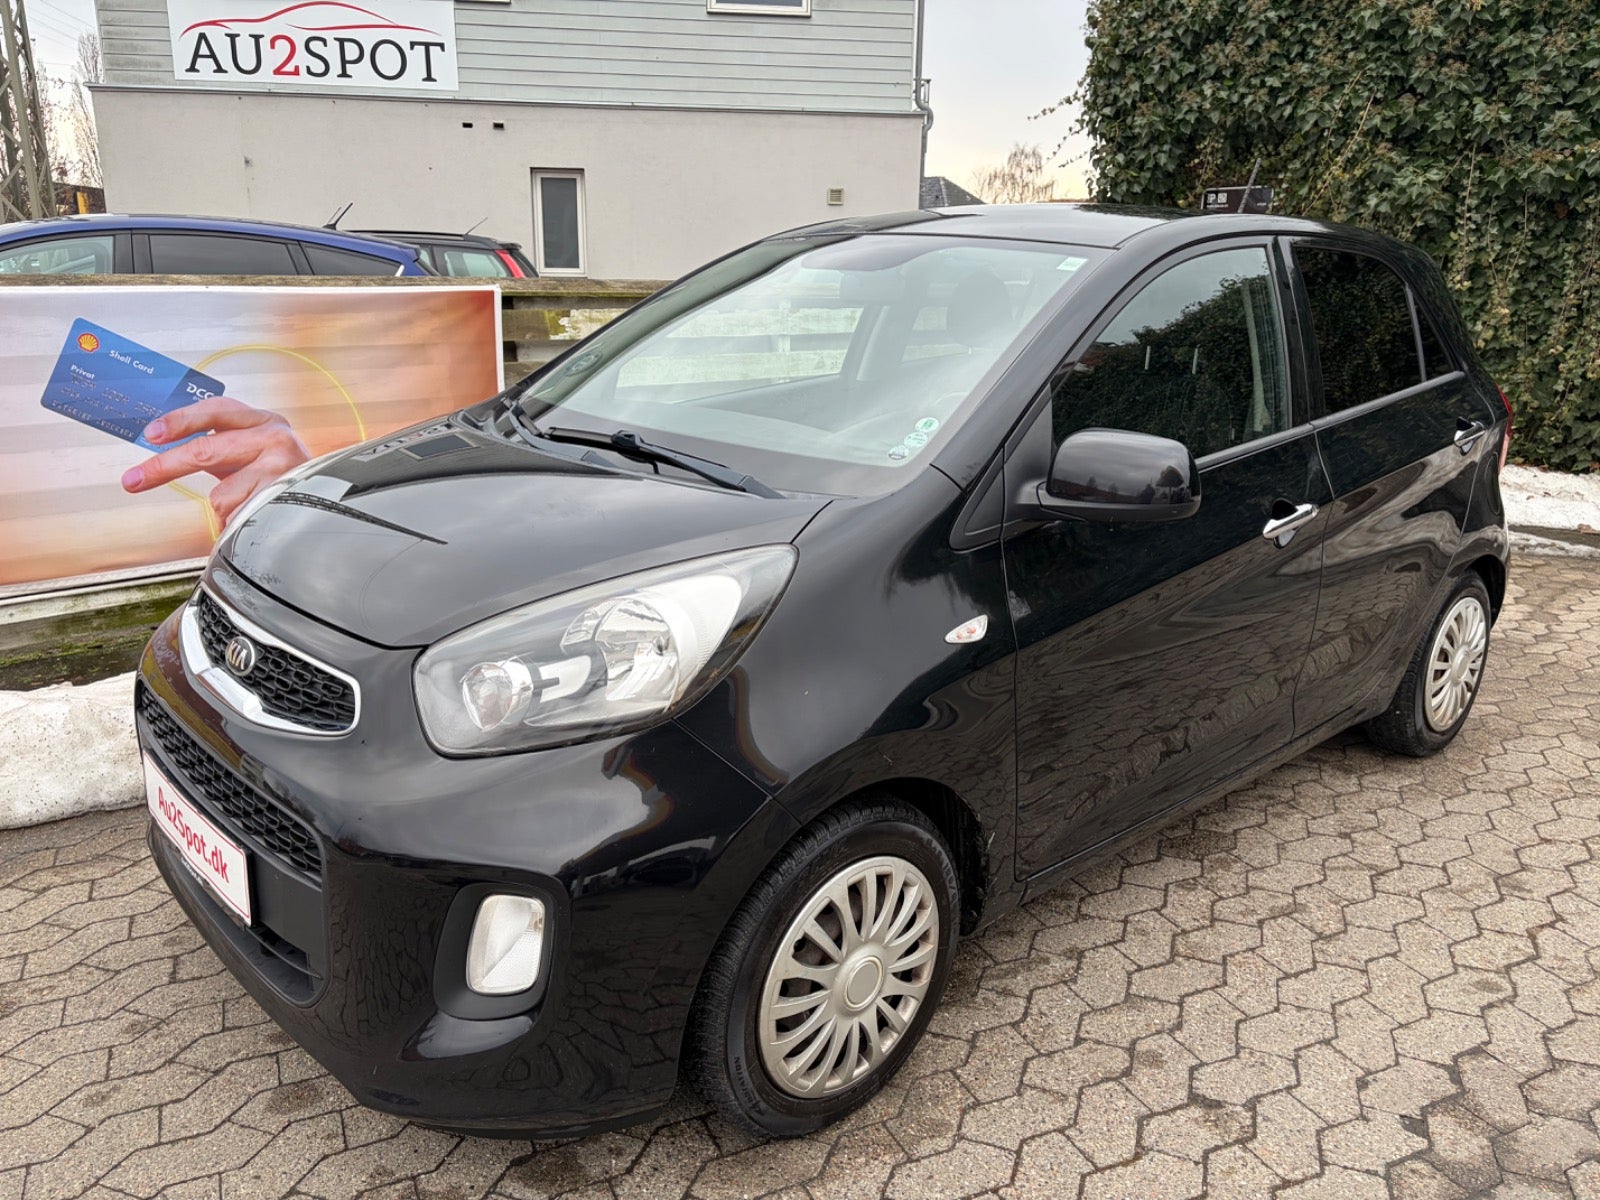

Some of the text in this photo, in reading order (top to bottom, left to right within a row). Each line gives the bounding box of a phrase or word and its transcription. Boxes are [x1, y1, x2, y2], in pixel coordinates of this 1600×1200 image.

[184, 32, 446, 83] AU2SPOT
[70, 364, 96, 379] Privat
[108, 349, 154, 375] Shell Card
[229, 640, 248, 670] KIA
[158, 785, 230, 884] Au2Spot.dk
